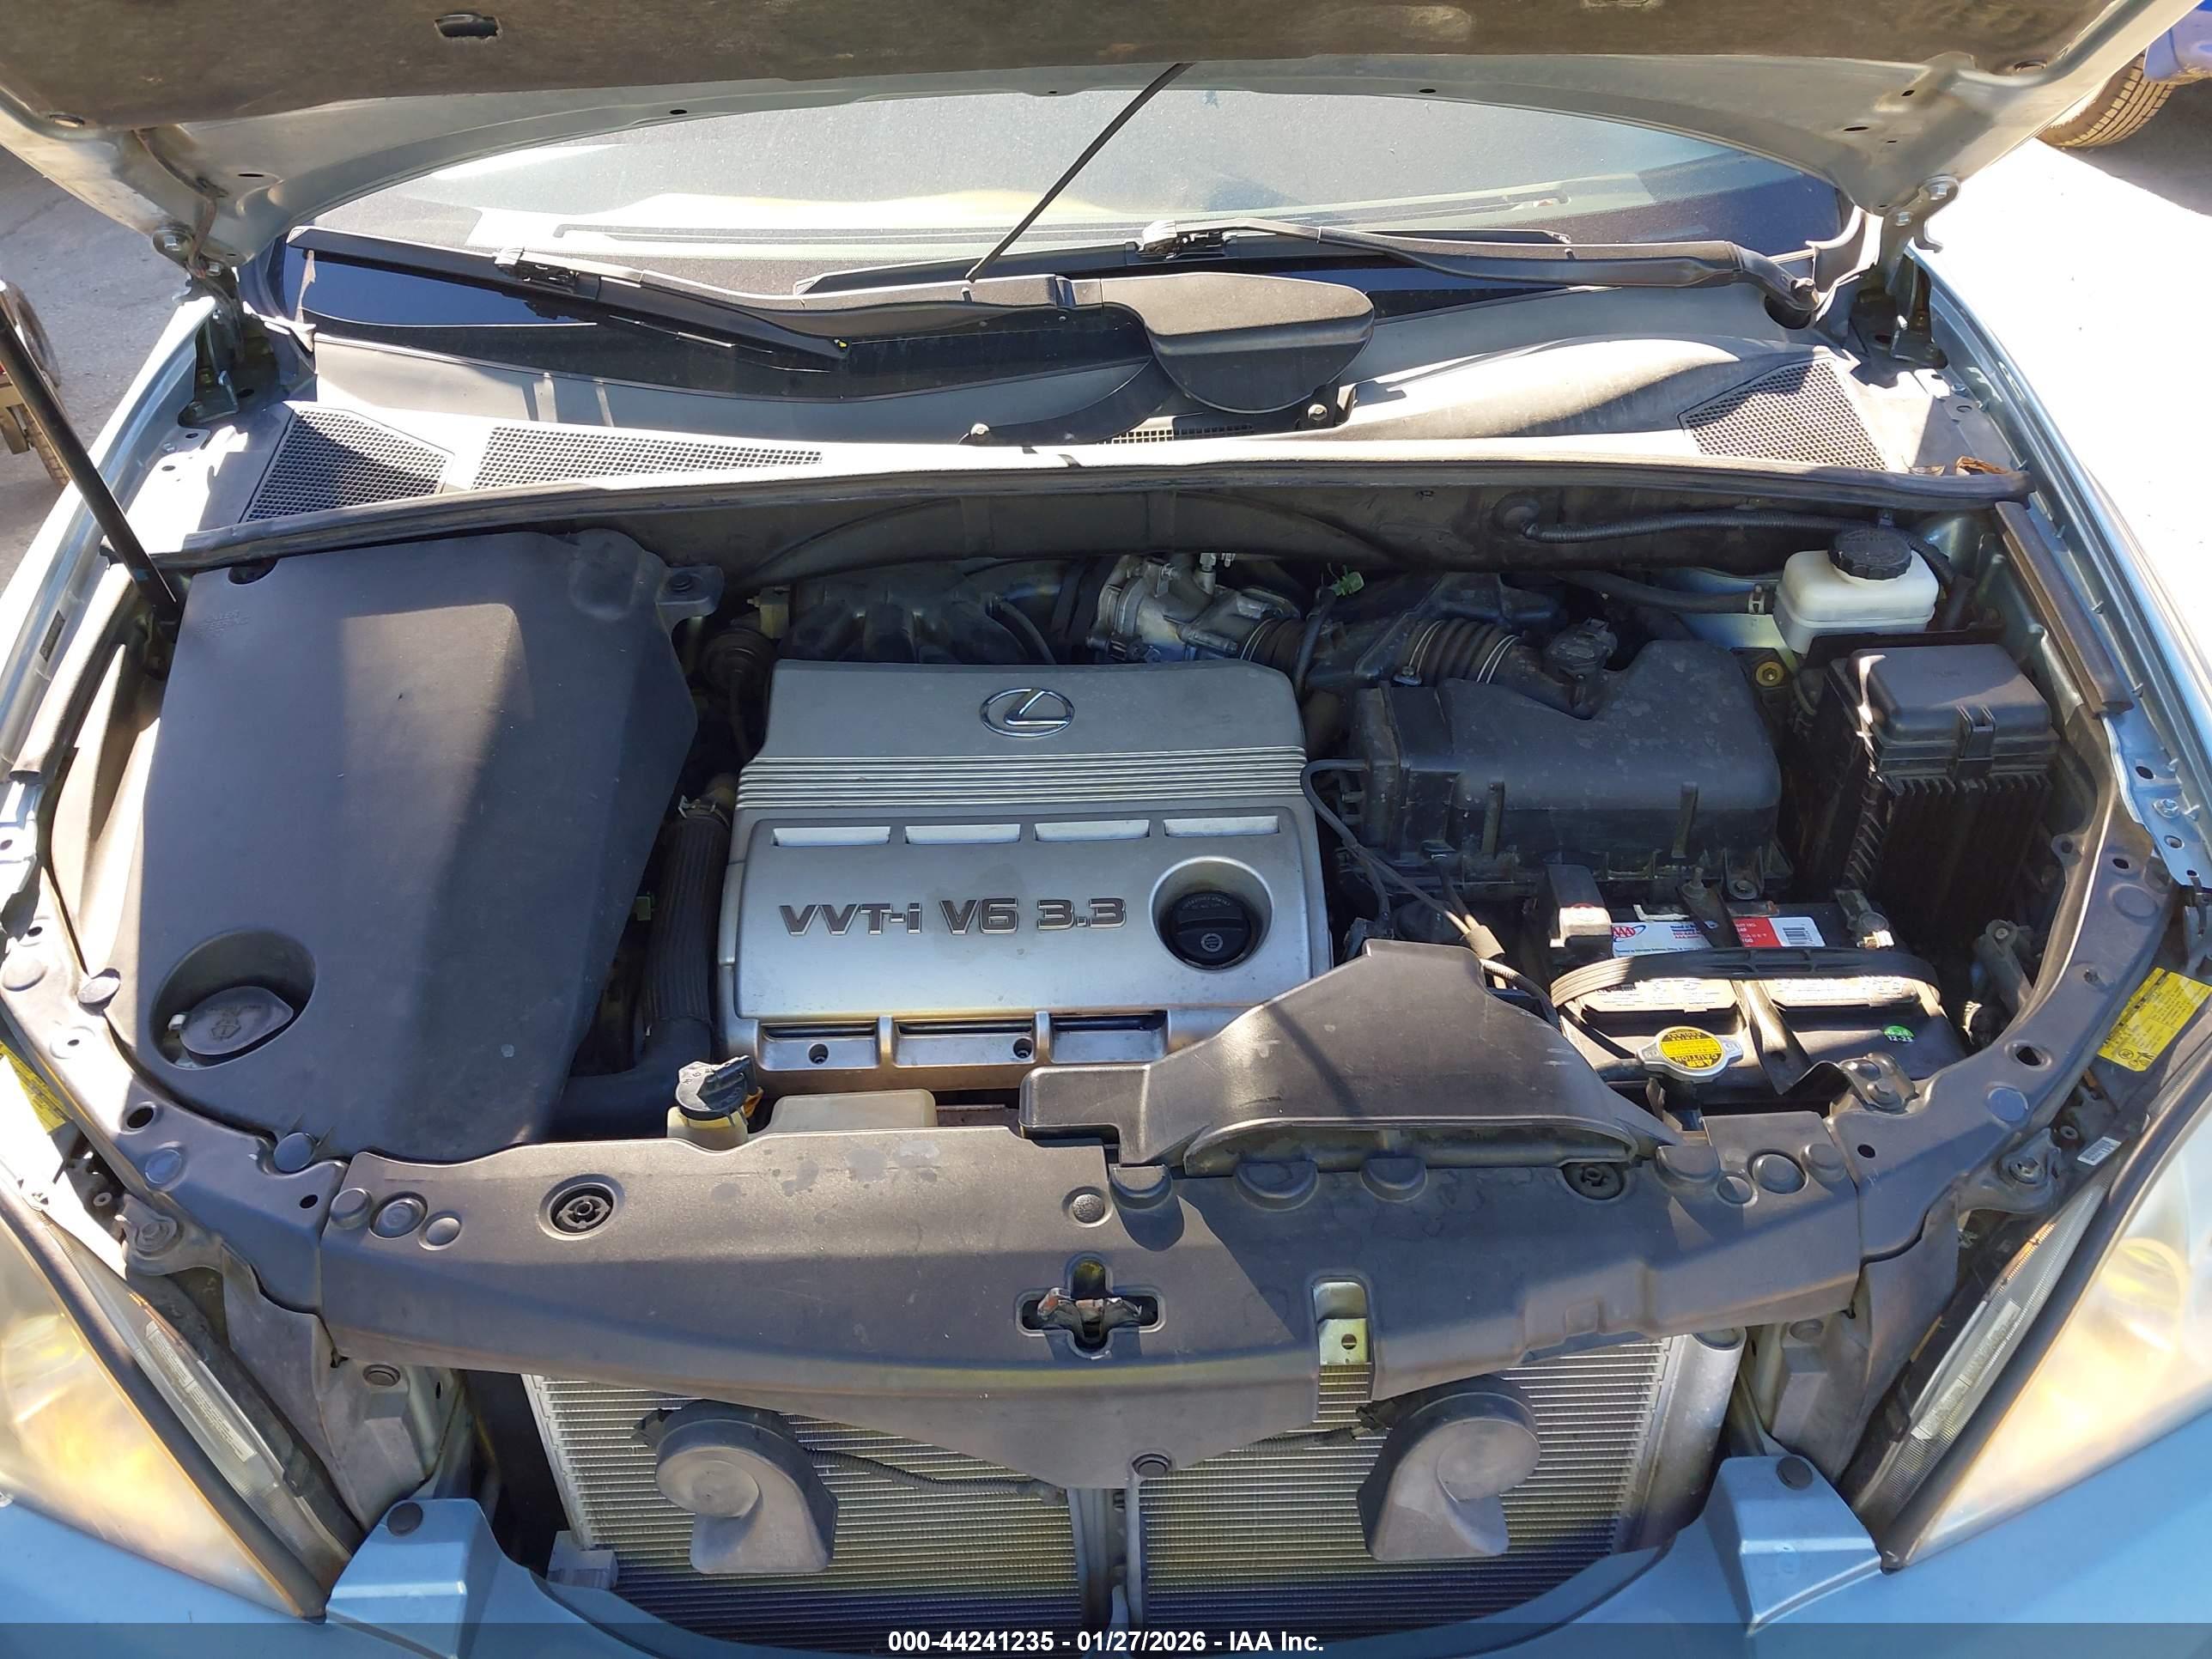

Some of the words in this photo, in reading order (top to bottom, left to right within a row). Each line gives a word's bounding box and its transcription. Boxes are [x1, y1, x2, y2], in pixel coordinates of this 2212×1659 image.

[779, 902, 923, 936] VVT-i
[940, 897, 1018, 935] V6
[1036, 897, 1127, 930] 3.3
[1612, 927, 1635, 938] AAA
[1674, 1053, 1718, 1063] CAUTION
